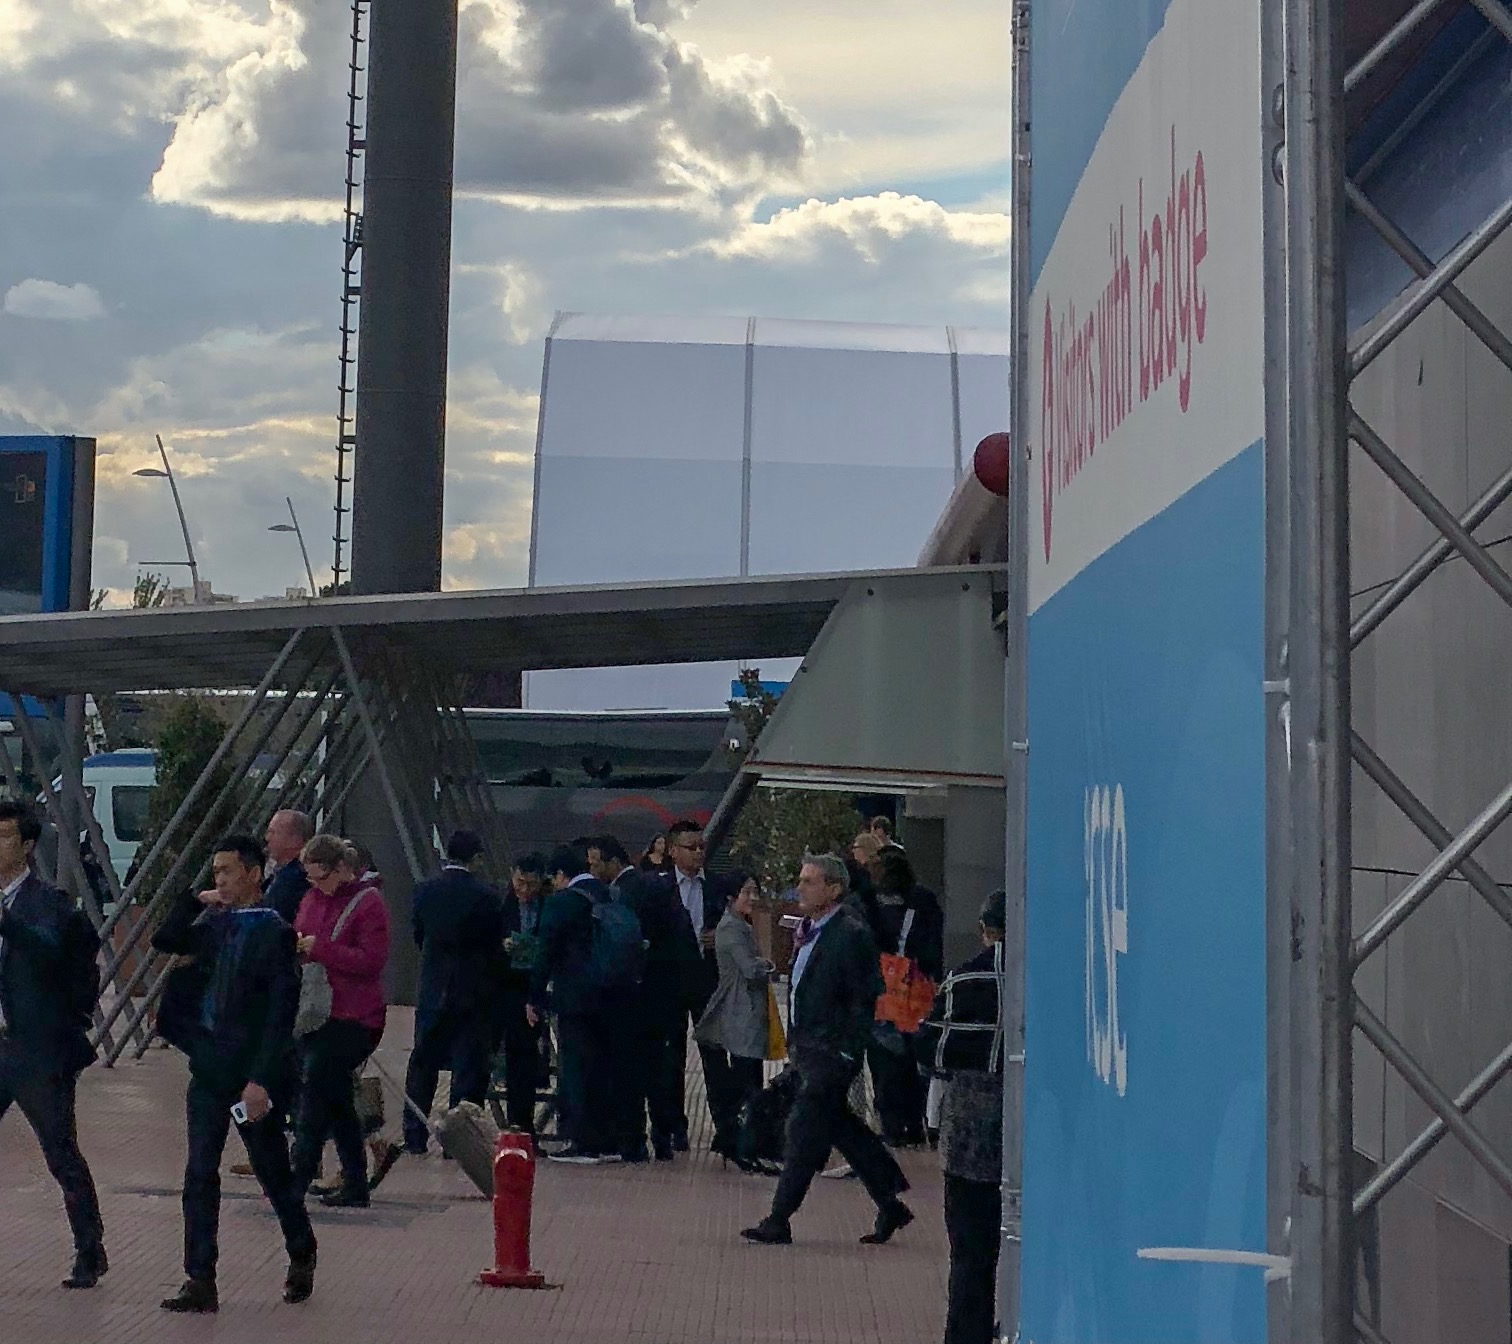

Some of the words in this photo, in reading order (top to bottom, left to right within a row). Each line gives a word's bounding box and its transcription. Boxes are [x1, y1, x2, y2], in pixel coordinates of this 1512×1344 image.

[1054, 297, 1095, 496] Visitors
[1098, 204, 1132, 444] with
[1138, 123, 1208, 414] badge
